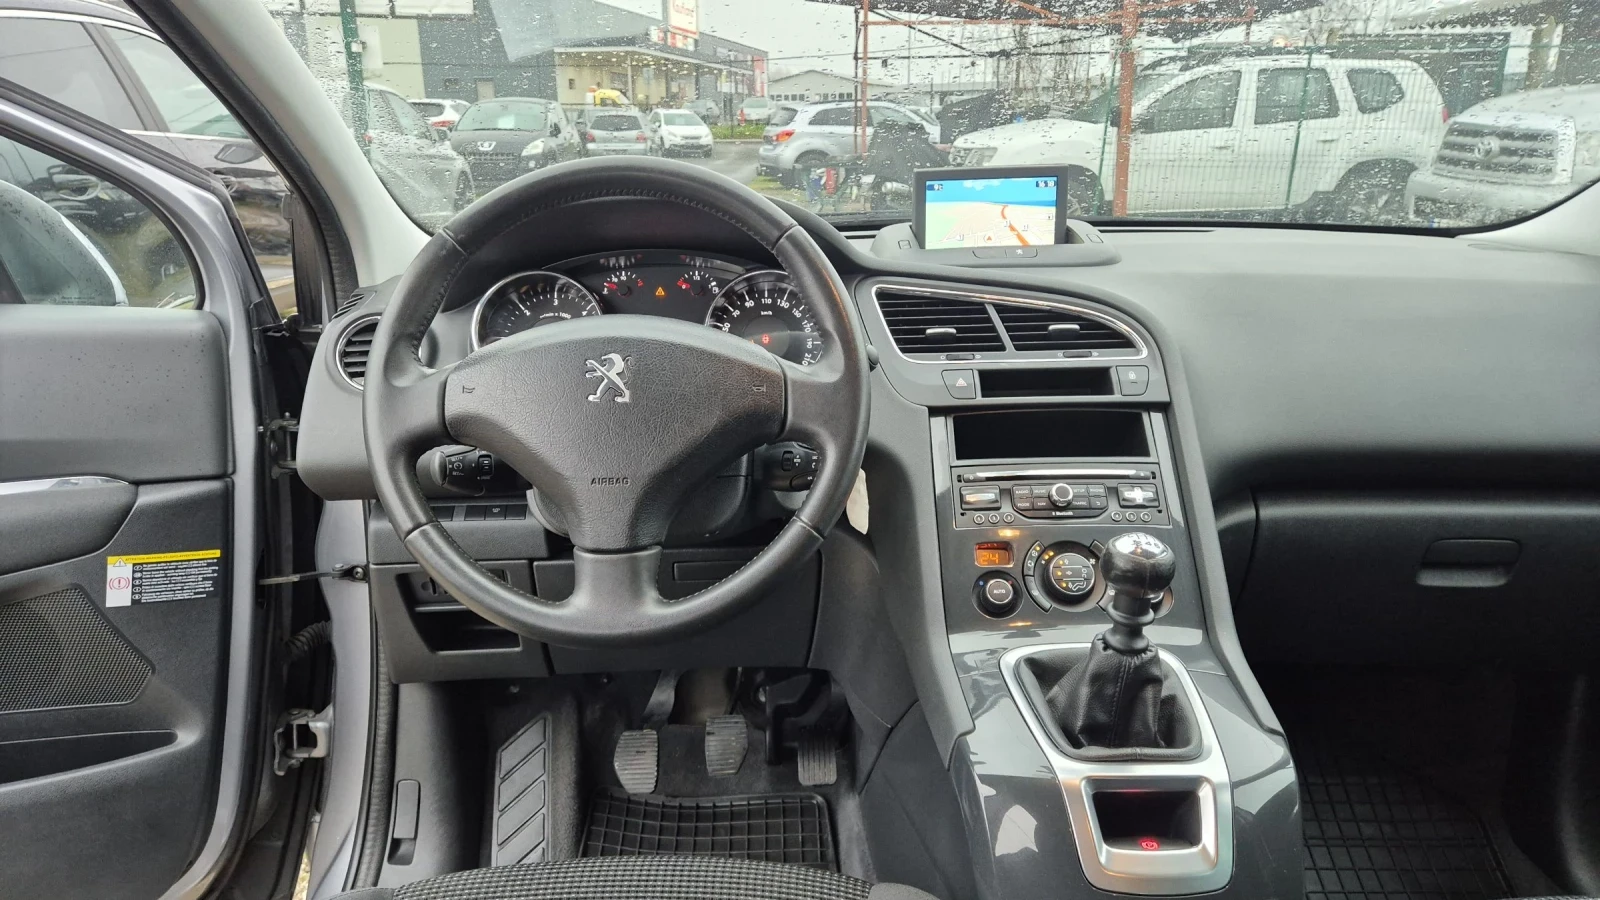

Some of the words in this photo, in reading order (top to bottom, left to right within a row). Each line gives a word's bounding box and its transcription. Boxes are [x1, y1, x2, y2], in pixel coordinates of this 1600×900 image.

[553, 298, 559, 306] 3
[744, 299, 755, 308] 90
[776, 298, 790, 309] 130
[523, 309, 531, 317] 2
[731, 309, 741, 318] 70
[791, 308, 802, 318] 150
[722, 322, 731, 333] 50
[801, 319, 812, 333] 170
[590, 477, 630, 487] AIRBAG
[980, 552, 999, 565] 24
